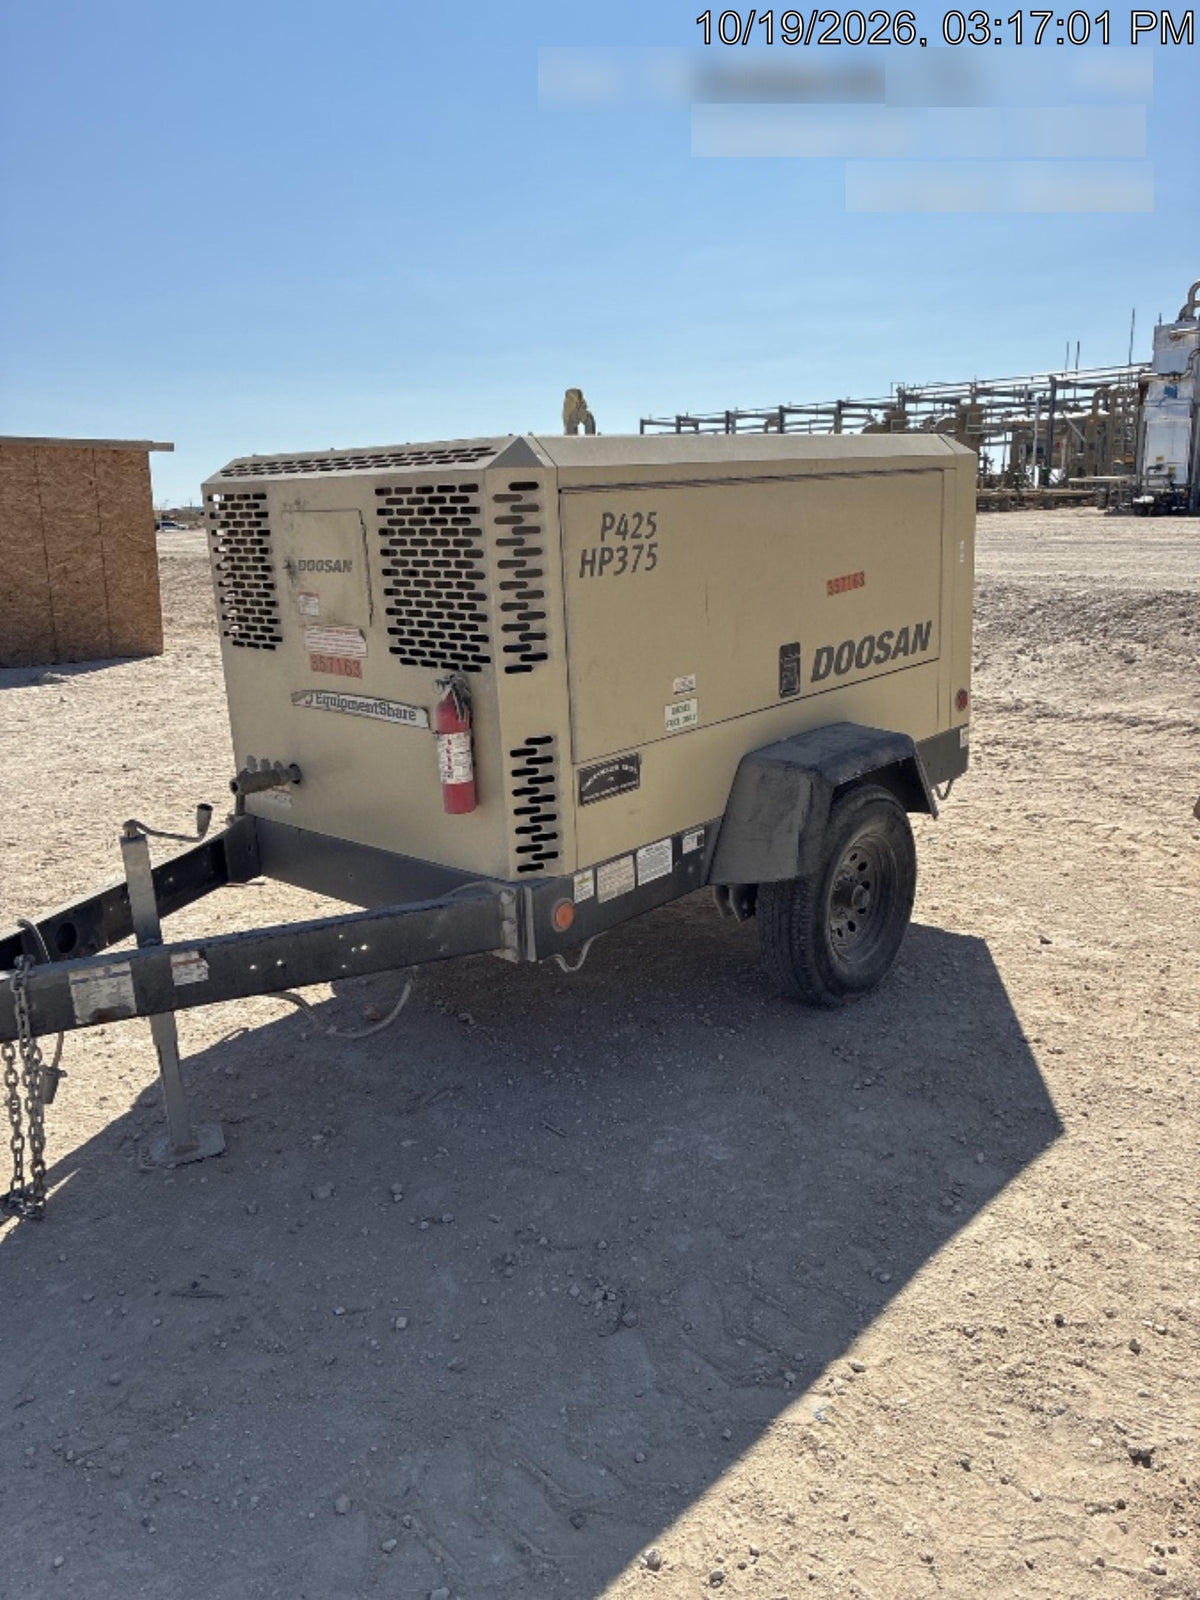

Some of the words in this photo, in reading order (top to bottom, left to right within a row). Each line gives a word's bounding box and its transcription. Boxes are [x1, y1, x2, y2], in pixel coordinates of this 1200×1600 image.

[601, 511, 657, 541] P425
[298, 559, 352, 573] DOOSAN
[579, 543, 658, 578] HP375
[810, 620, 932, 683] DOOSAN
[315, 692, 416, 720] EquipmentShare
